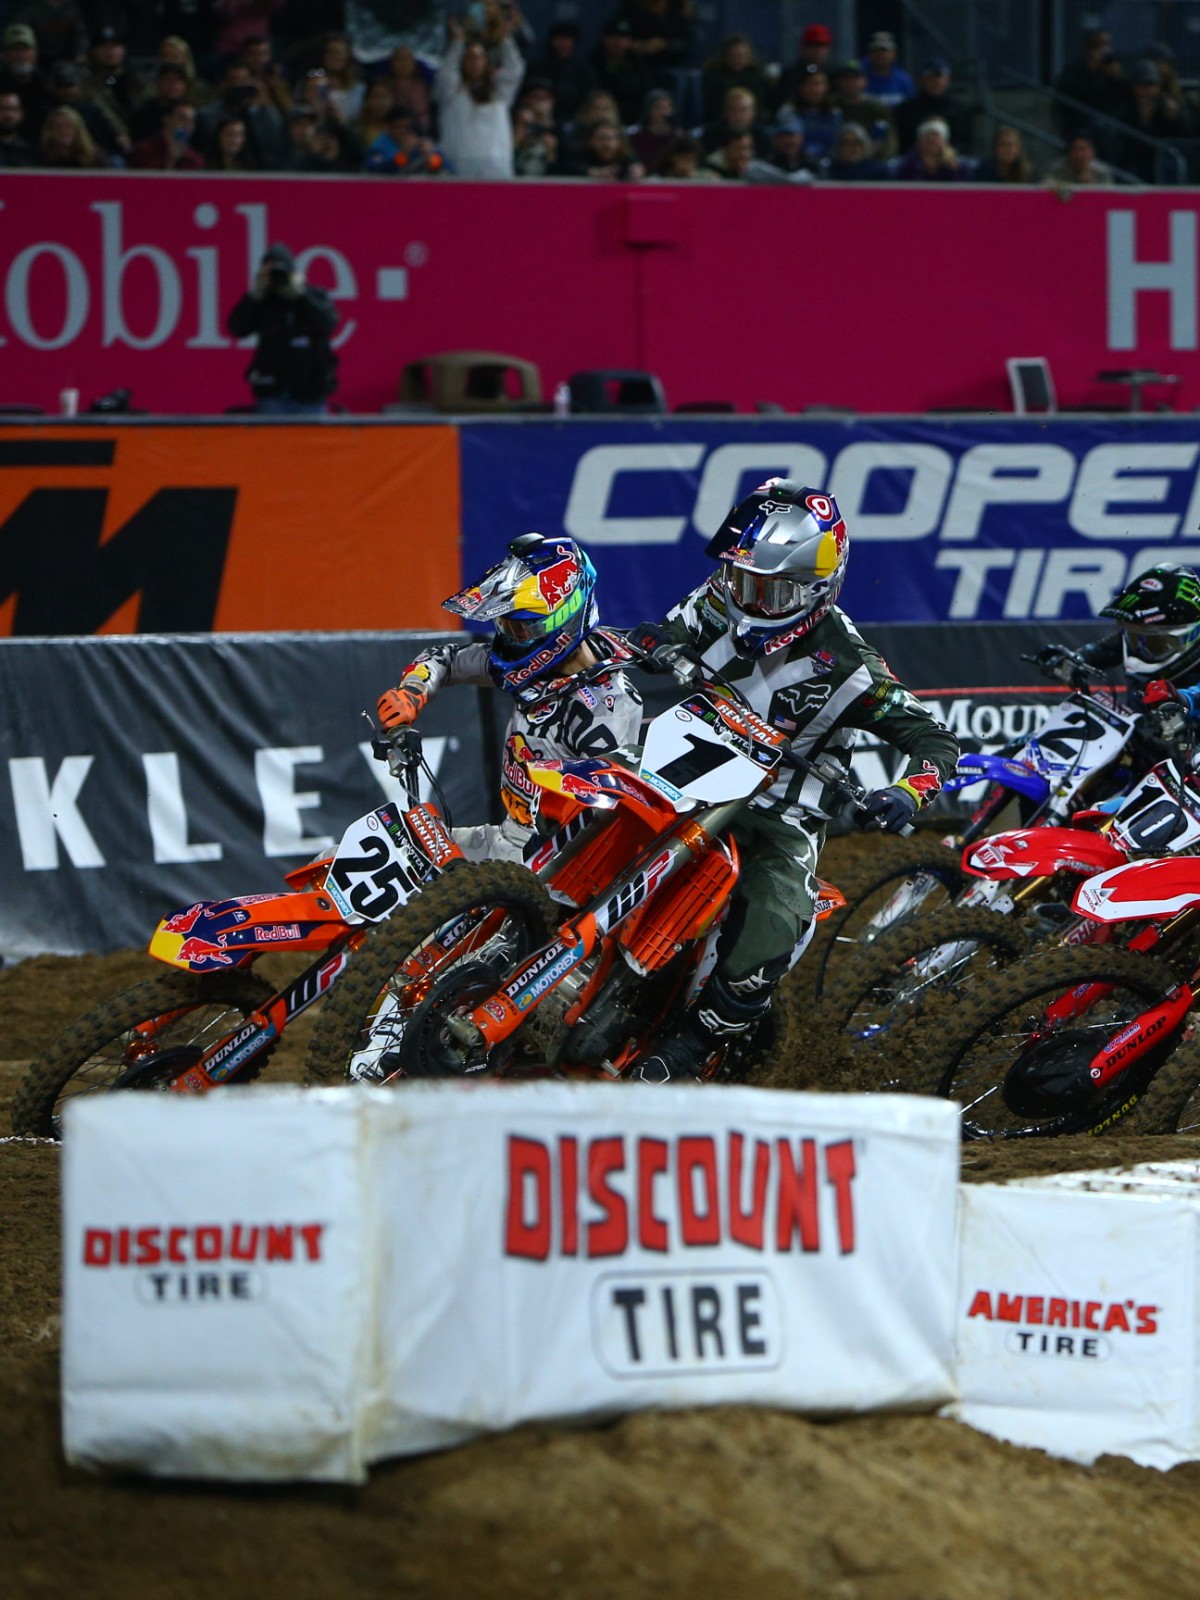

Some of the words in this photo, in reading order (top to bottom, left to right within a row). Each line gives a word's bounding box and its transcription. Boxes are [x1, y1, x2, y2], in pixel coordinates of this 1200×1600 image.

[0, 201, 358, 350] obile
[542, 588, 583, 633] 100
[655, 732, 739, 790] 1
[1038, 711, 1107, 761] 2
[648, 775, 682, 801] MOTOREX
[1114, 784, 1189, 850] 10
[331, 835, 415, 919] 25
[507, 942, 564, 998] DUNLOP
[530, 949, 579, 998] MOTOREX
[224, 1031, 272, 1070] MOTOREX
[1104, 1015, 1167, 1068] DUNLOP
[502, 1129, 858, 1263] DISCOUNT
[82, 1222, 326, 1267] DISCOUNT
[149, 1272, 253, 1300] TIRE
[611, 1283, 769, 1365] TIRE
[966, 1289, 1160, 1335] AMERICA'S
[1016, 1331, 1099, 1358] TIRE
